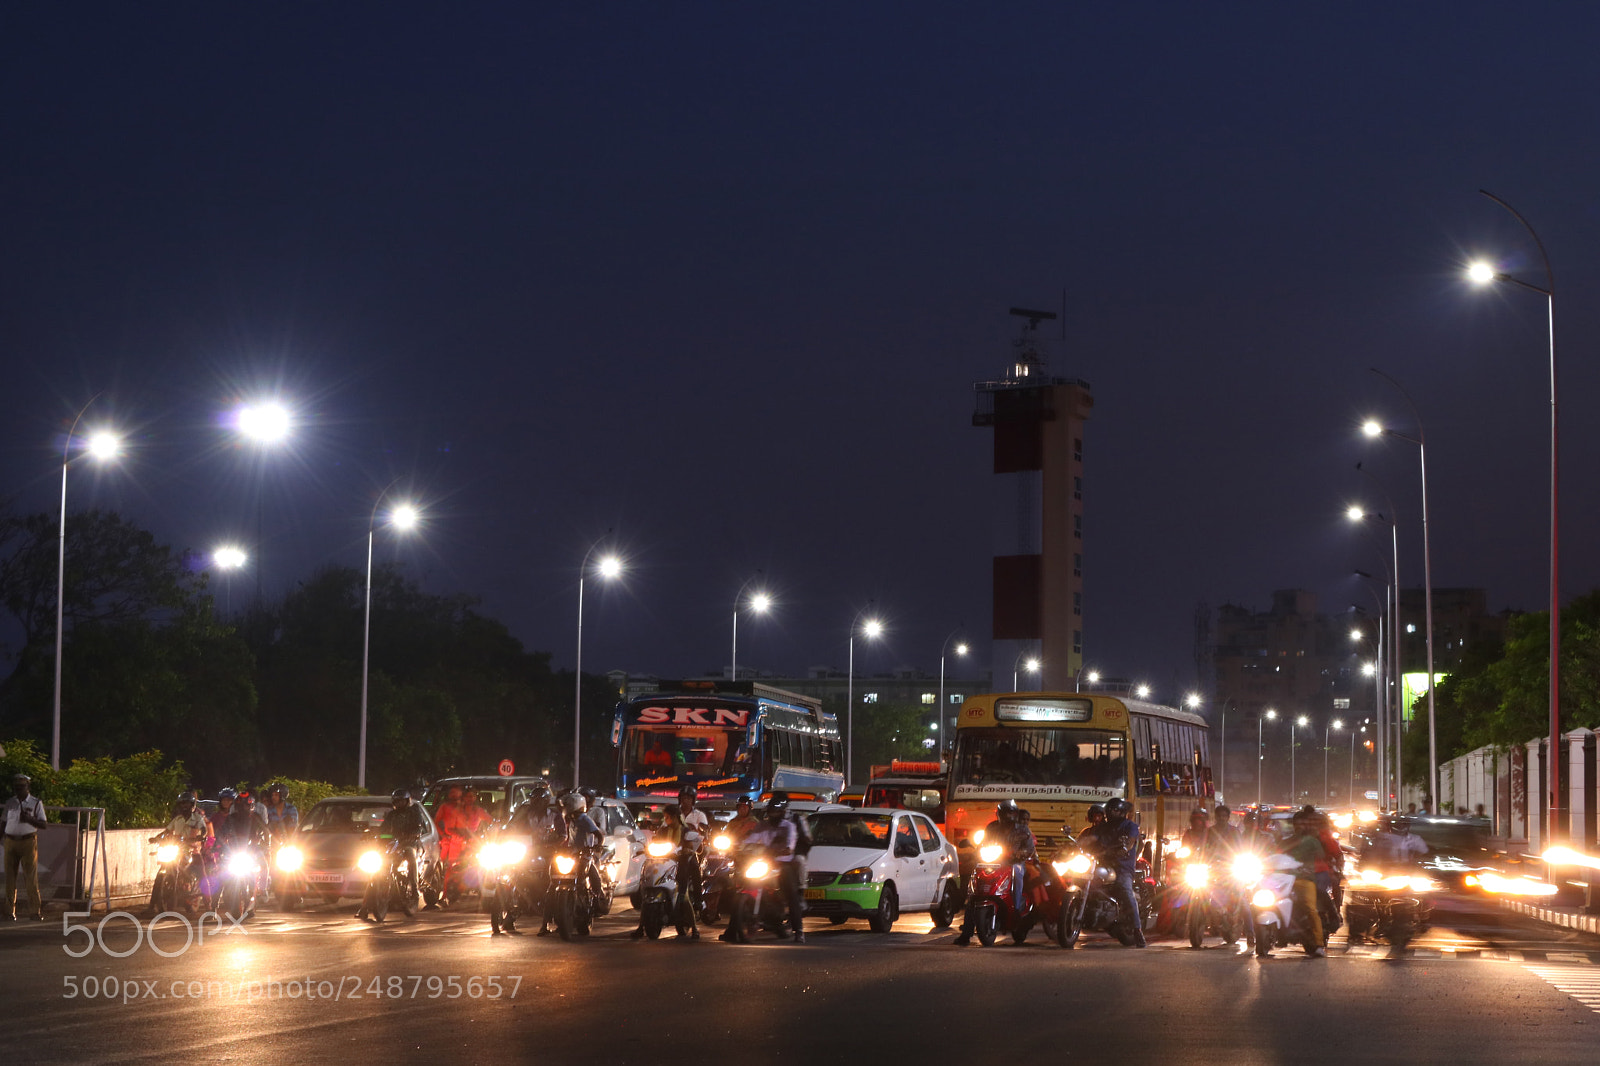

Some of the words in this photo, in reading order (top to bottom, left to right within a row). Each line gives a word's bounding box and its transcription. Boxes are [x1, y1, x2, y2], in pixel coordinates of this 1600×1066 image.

[637, 707, 750, 726] SKN
[968, 709, 983, 718] MTC
[1105, 709, 1122, 718] MTC
[501, 765, 511, 773] 40
